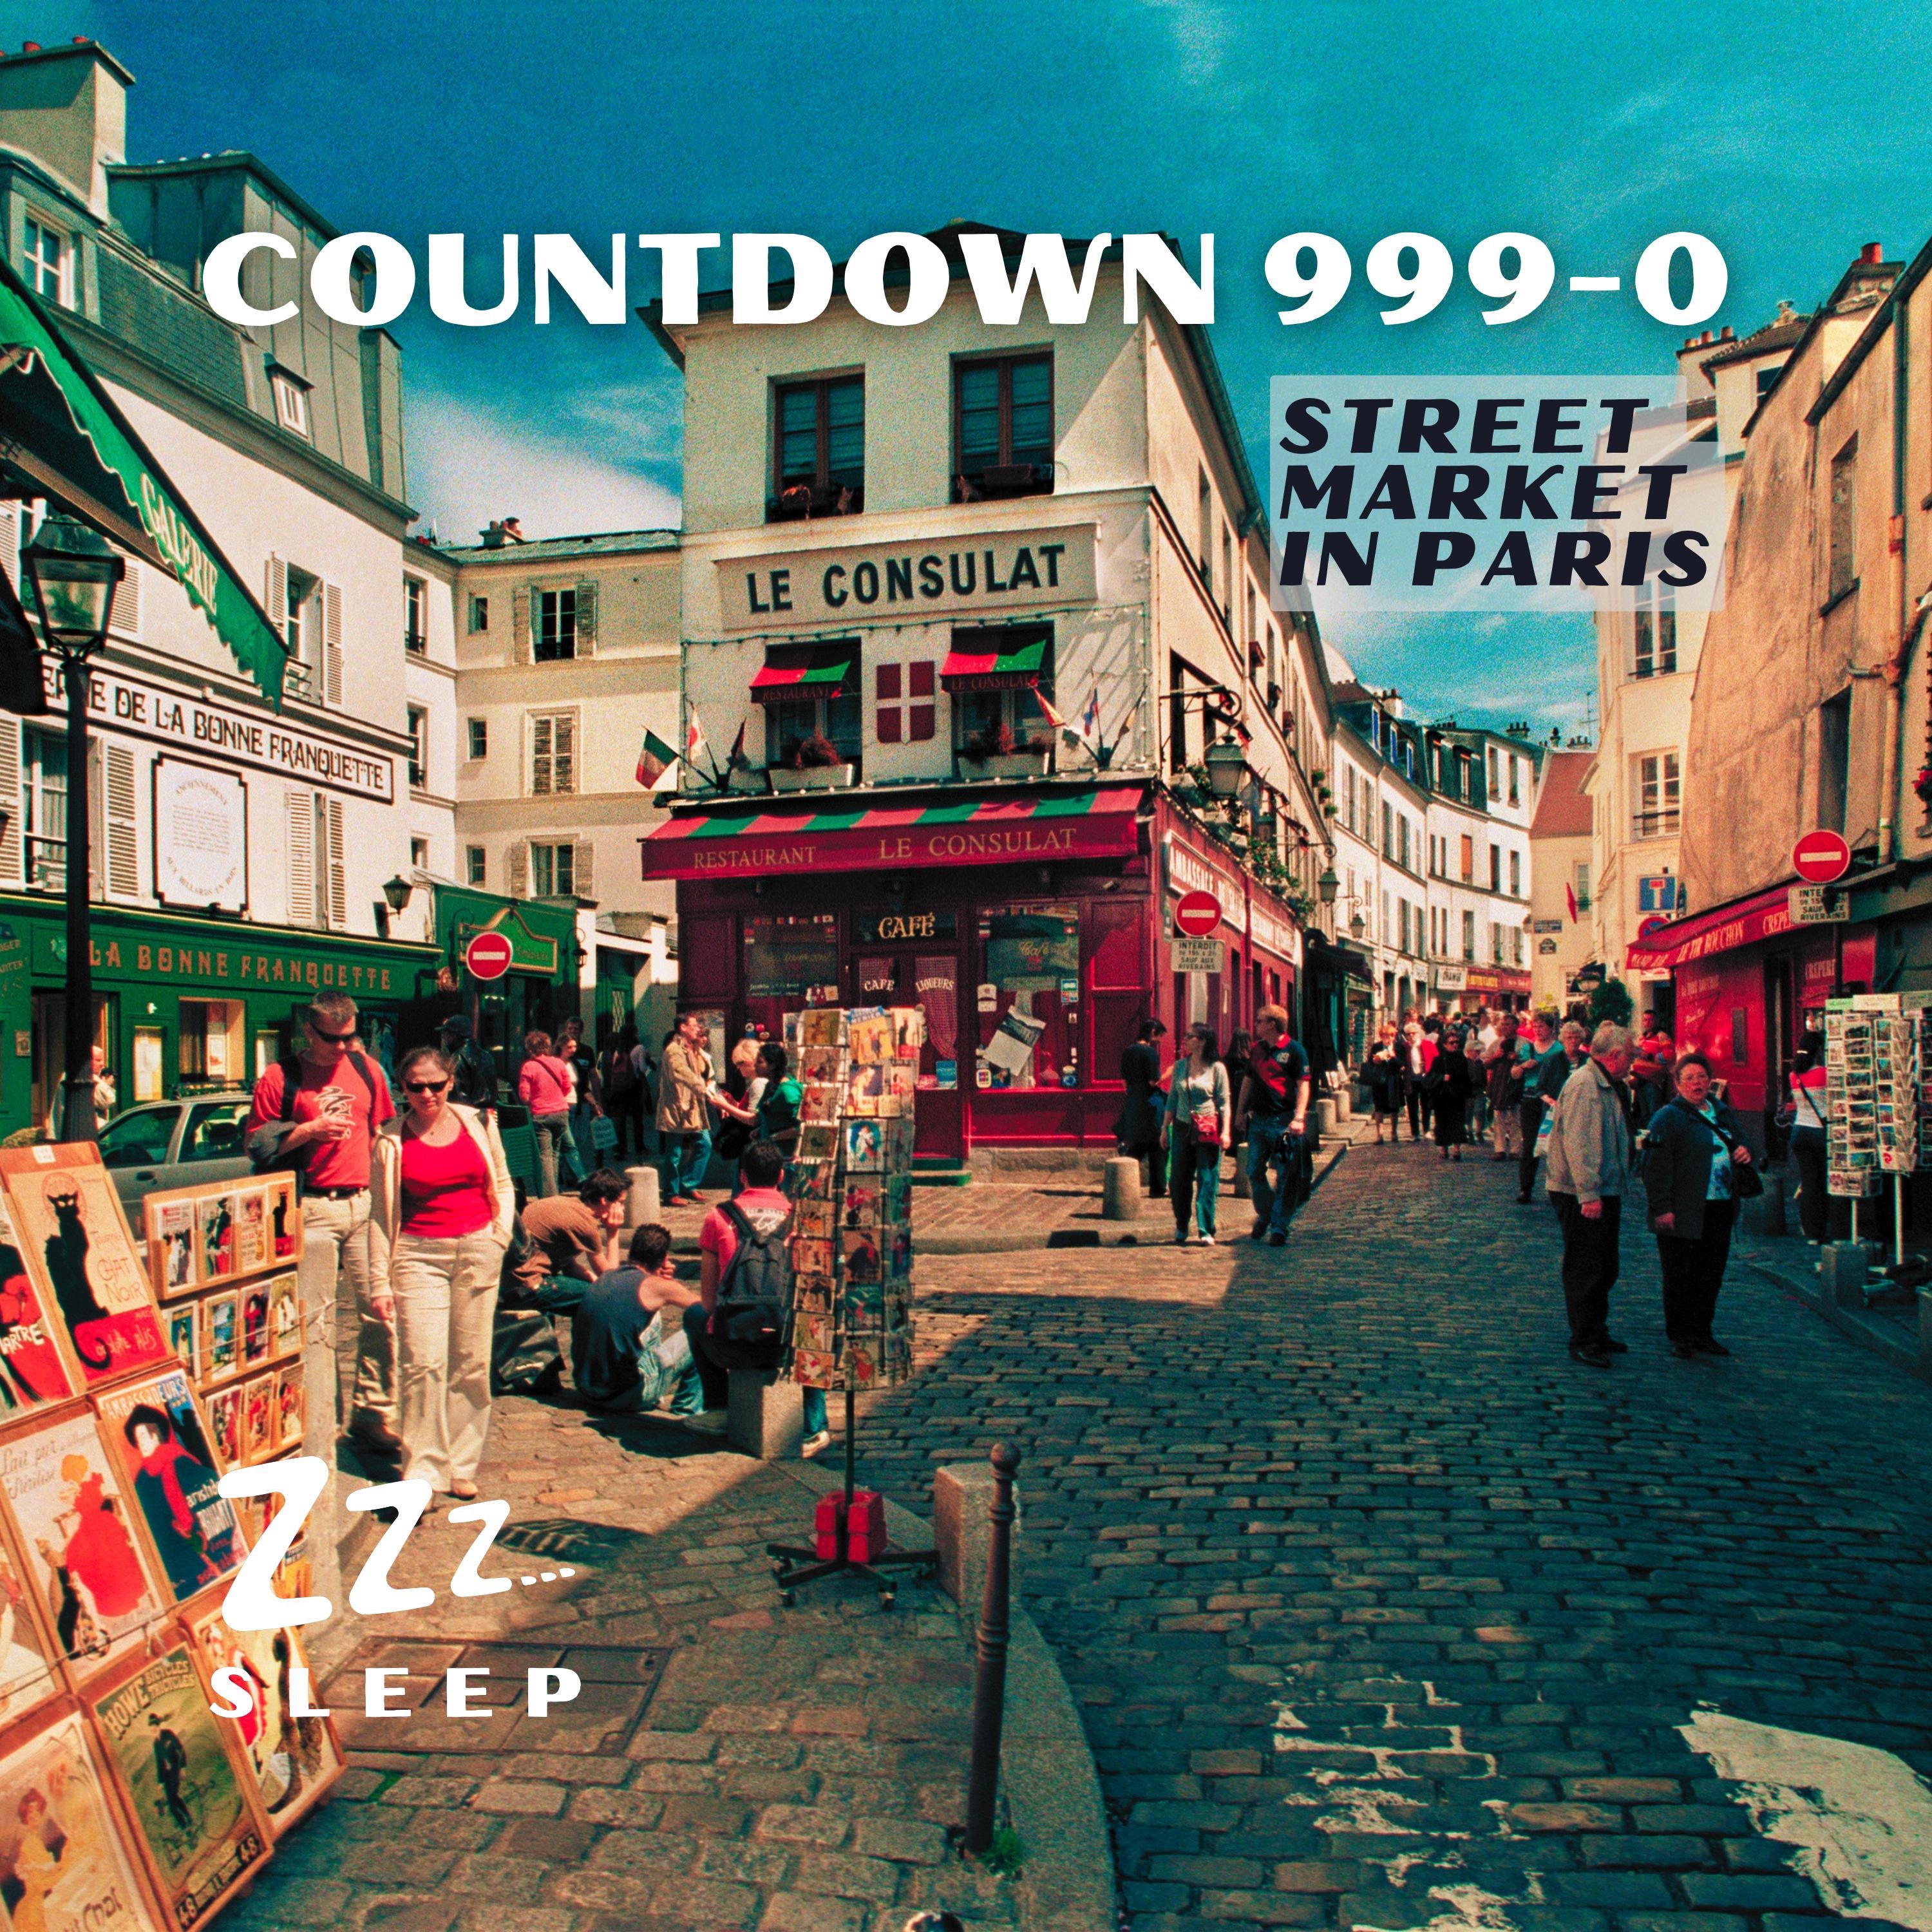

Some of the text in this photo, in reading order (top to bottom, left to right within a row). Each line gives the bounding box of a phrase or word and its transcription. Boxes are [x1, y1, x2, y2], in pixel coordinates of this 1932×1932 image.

[140, 472, 218, 616] GALERIE
[747, 544, 1065, 612] LE CONSULAT
[115, 687, 146, 723] DE
[155, 698, 185, 735] LA
[194, 710, 263, 755] BONNE
[270, 733, 384, 790] FRANQUETTE
[694, 828, 1076, 869] RESTAURANT LE CONSULAT
[878, 912, 936, 939] CAFÉ
[89, 940, 390, 990] LA BONNE FRANQUETTE
[915, 977, 954, 992] LIQUEURS
[106, 1376, 187, 1420] AMBASSADEURS
[103, 1674, 151, 1740] HOWE
